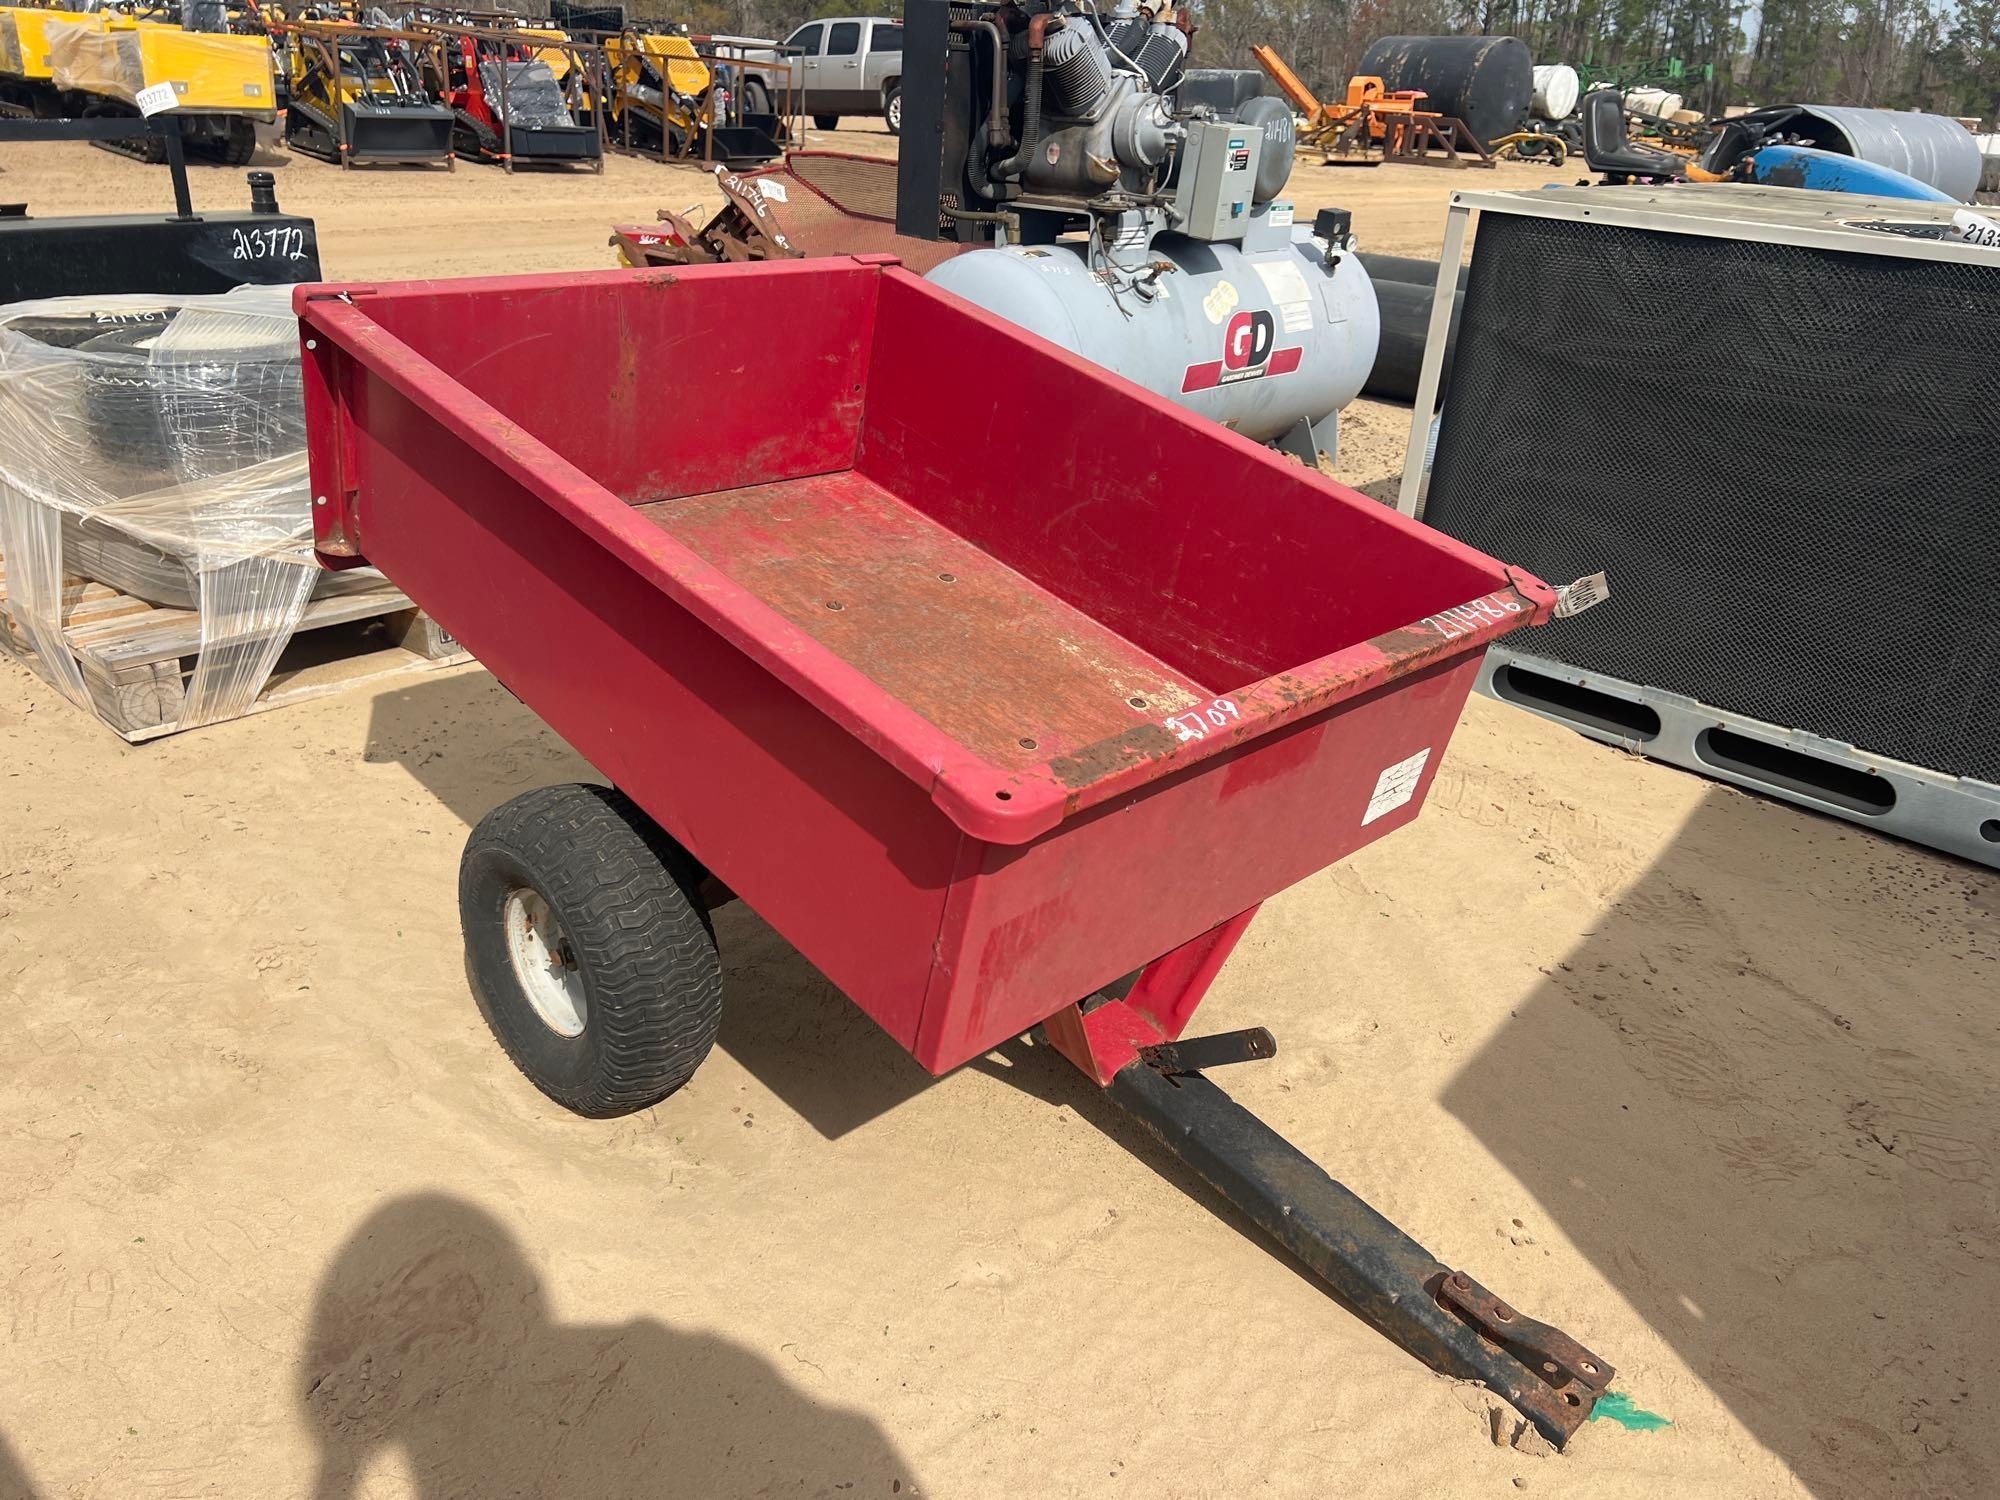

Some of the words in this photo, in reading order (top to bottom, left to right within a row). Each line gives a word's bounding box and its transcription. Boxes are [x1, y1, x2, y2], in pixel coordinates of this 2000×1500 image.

[233, 227, 309, 261] 213772
[1225, 310, 1275, 371] GD
[1421, 594, 1521, 639] 211486
[1162, 698, 1241, 742] 2709
